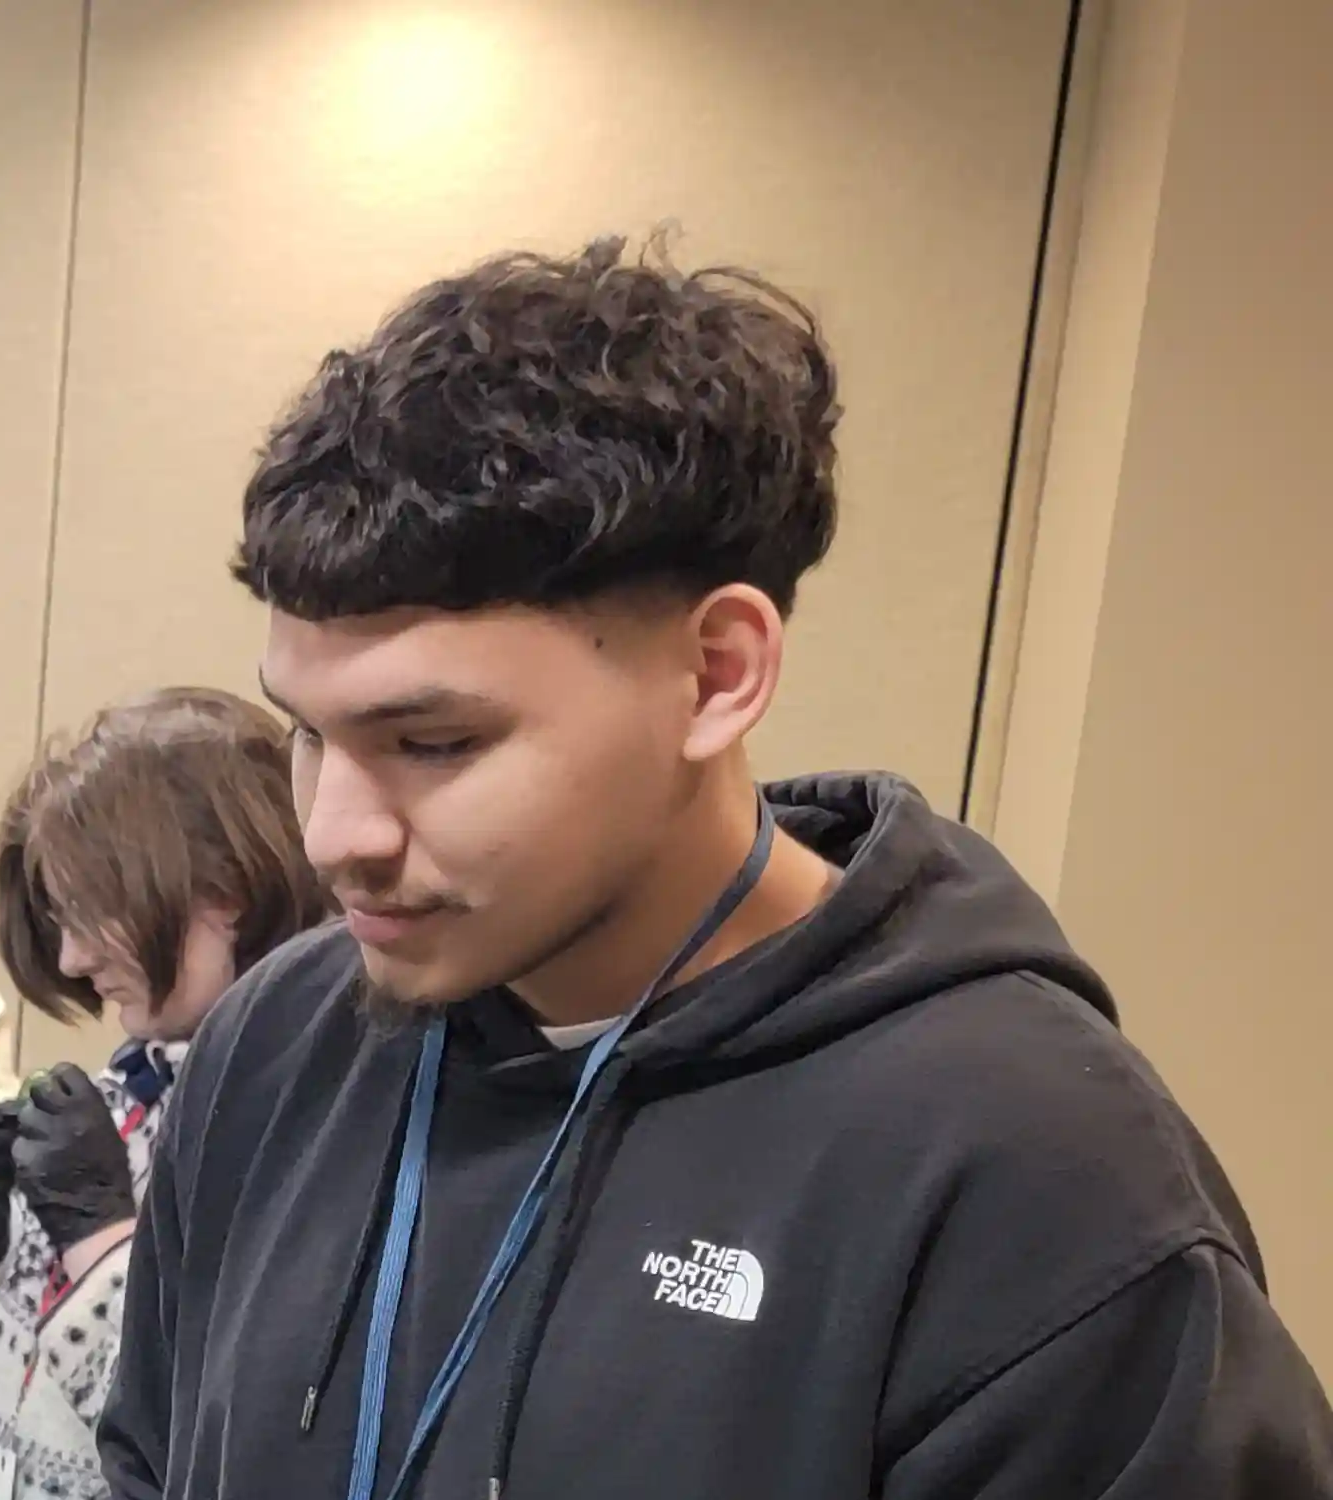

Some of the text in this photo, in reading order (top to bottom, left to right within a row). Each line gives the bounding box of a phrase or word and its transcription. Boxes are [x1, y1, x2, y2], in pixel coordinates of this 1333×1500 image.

[641, 1251, 732, 1293] NORTH
[691, 1239, 740, 1272] THE
[654, 1278, 722, 1313] FACE
